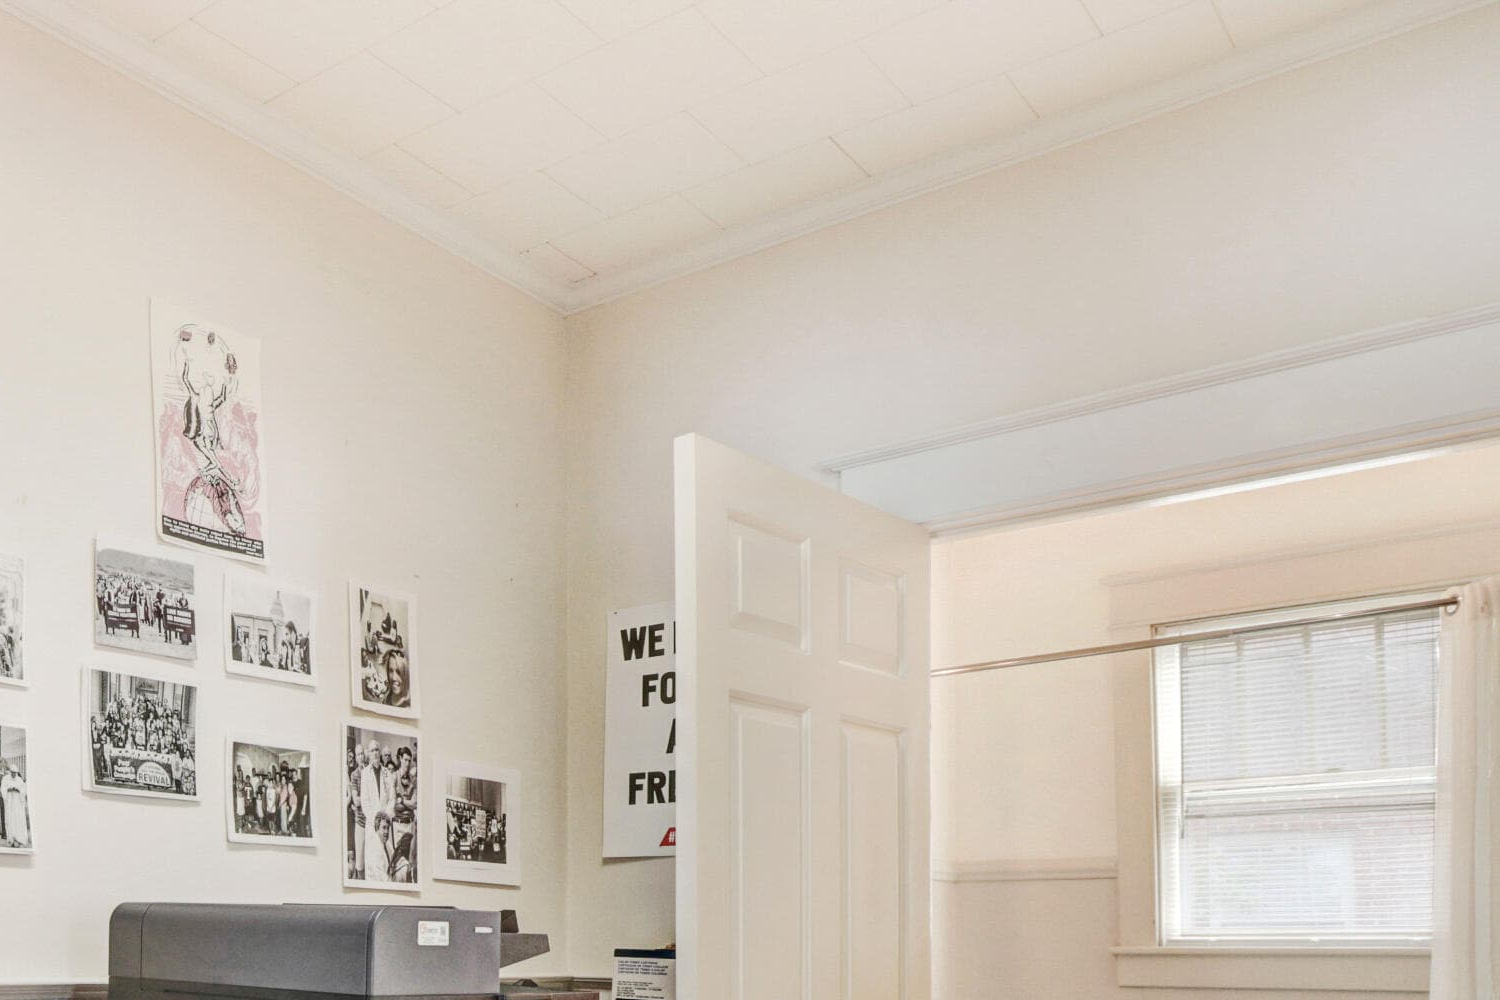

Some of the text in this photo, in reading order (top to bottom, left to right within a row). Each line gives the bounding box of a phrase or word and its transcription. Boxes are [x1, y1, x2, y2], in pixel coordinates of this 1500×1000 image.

[620, 622, 665, 661] WE
[642, 671, 676, 707] FO
[138, 772, 170, 786] REVIVAL
[628, 770, 676, 805] FRI
